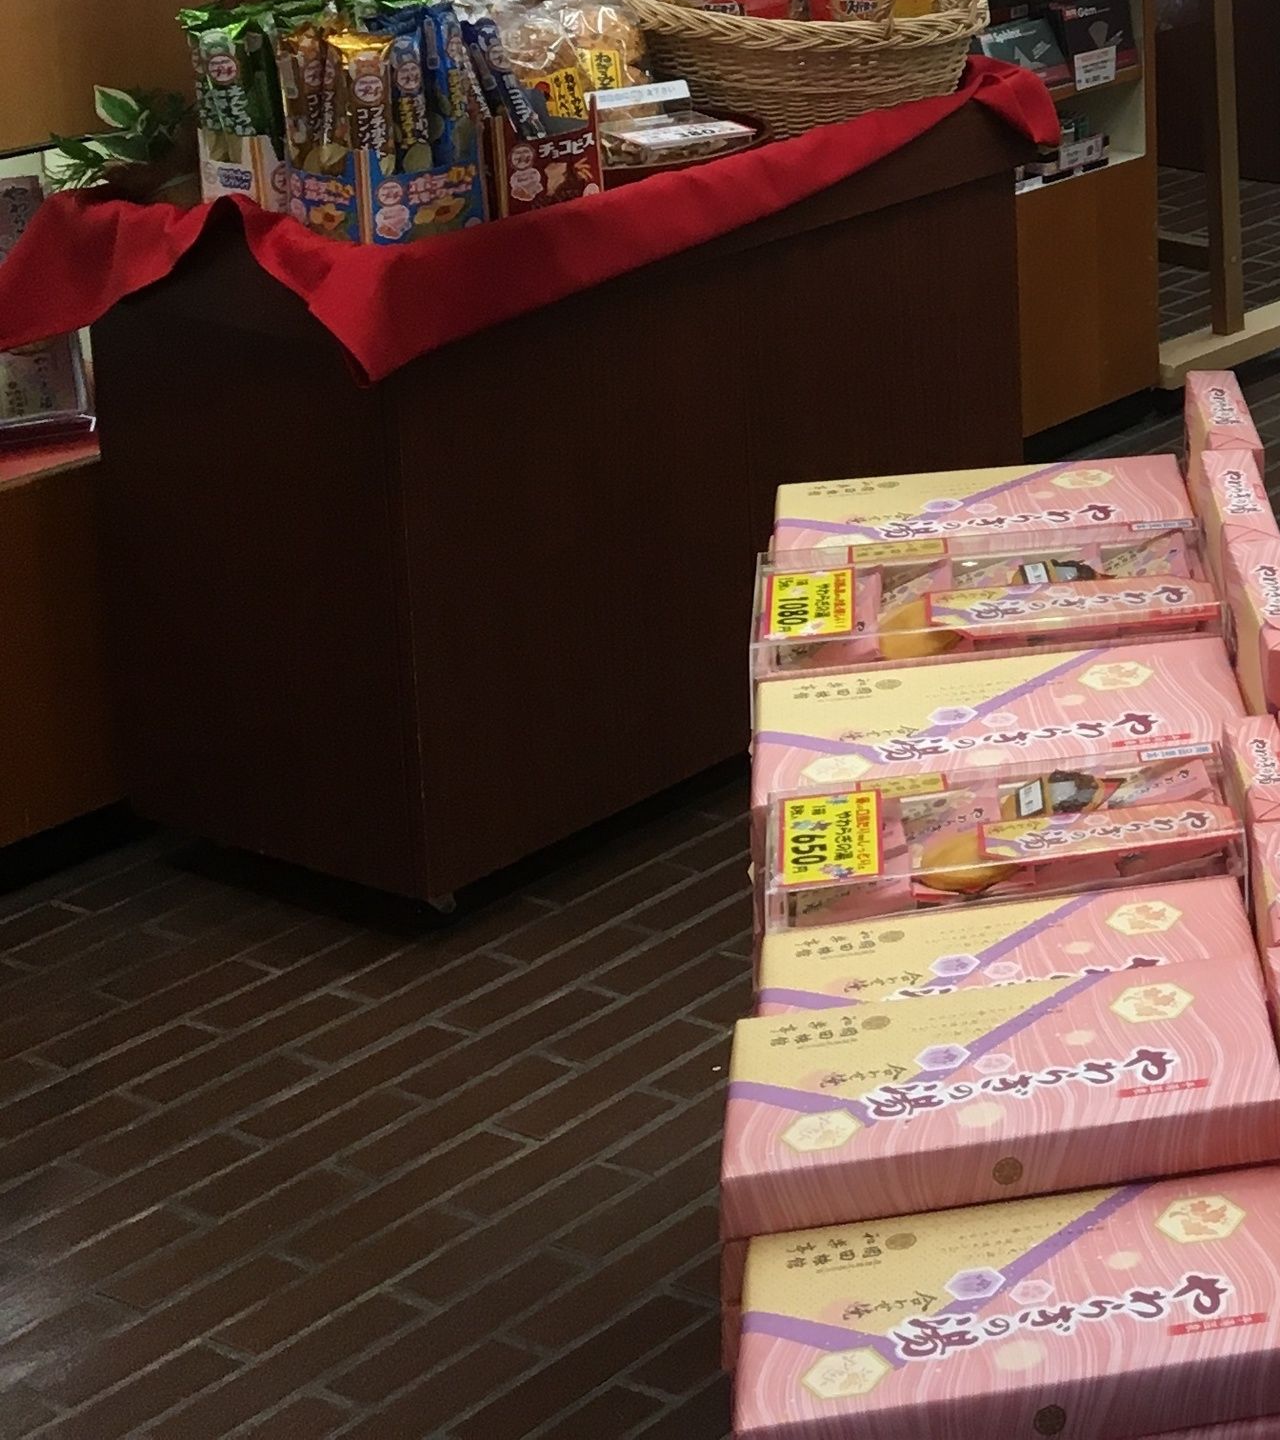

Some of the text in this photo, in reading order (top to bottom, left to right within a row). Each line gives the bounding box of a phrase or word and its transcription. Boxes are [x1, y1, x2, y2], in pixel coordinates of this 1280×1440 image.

[538, 133, 595, 160] チョコビス
[775, 595, 811, 635] 1080円
[791, 831, 828, 875] 650円
